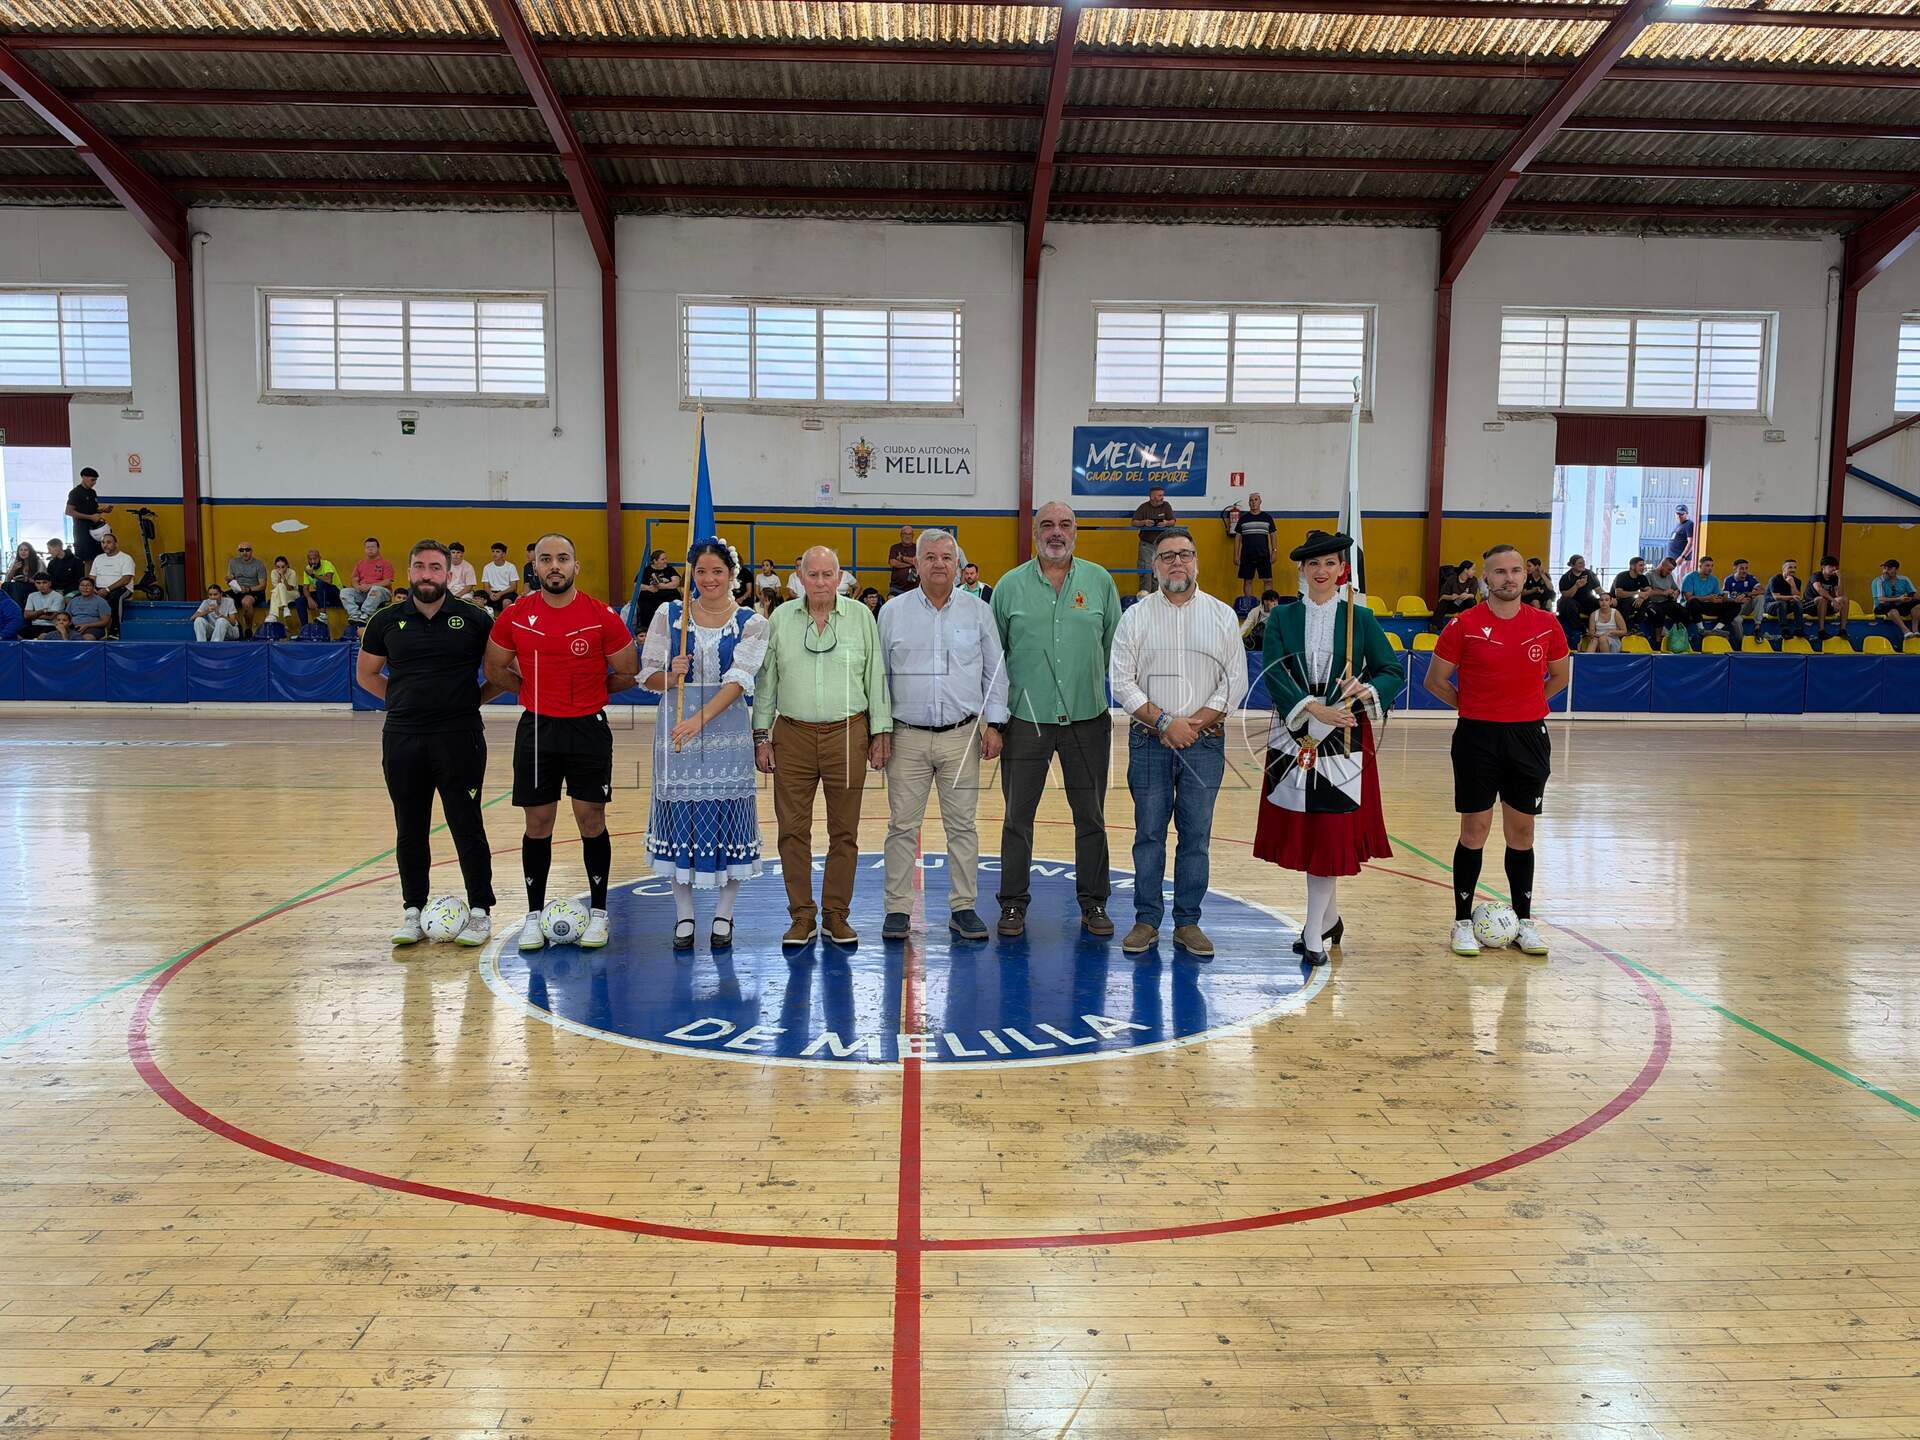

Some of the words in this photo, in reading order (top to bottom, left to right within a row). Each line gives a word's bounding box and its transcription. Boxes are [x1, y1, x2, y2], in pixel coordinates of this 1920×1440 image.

[883, 445, 916, 454] CIUDAD
[918, 446, 970, 455] AUTÓNOMA
[1086, 441, 1195, 470] MELILLA
[885, 456, 970, 474] MELILLA
[1086, 471, 1122, 481] CIUDAD
[1125, 471, 1144, 481] DEL
[1148, 471, 1190, 482] DEPORTE
[665, 1017, 790, 1050] DE
[800, 1014, 1152, 1059] MELILLA
